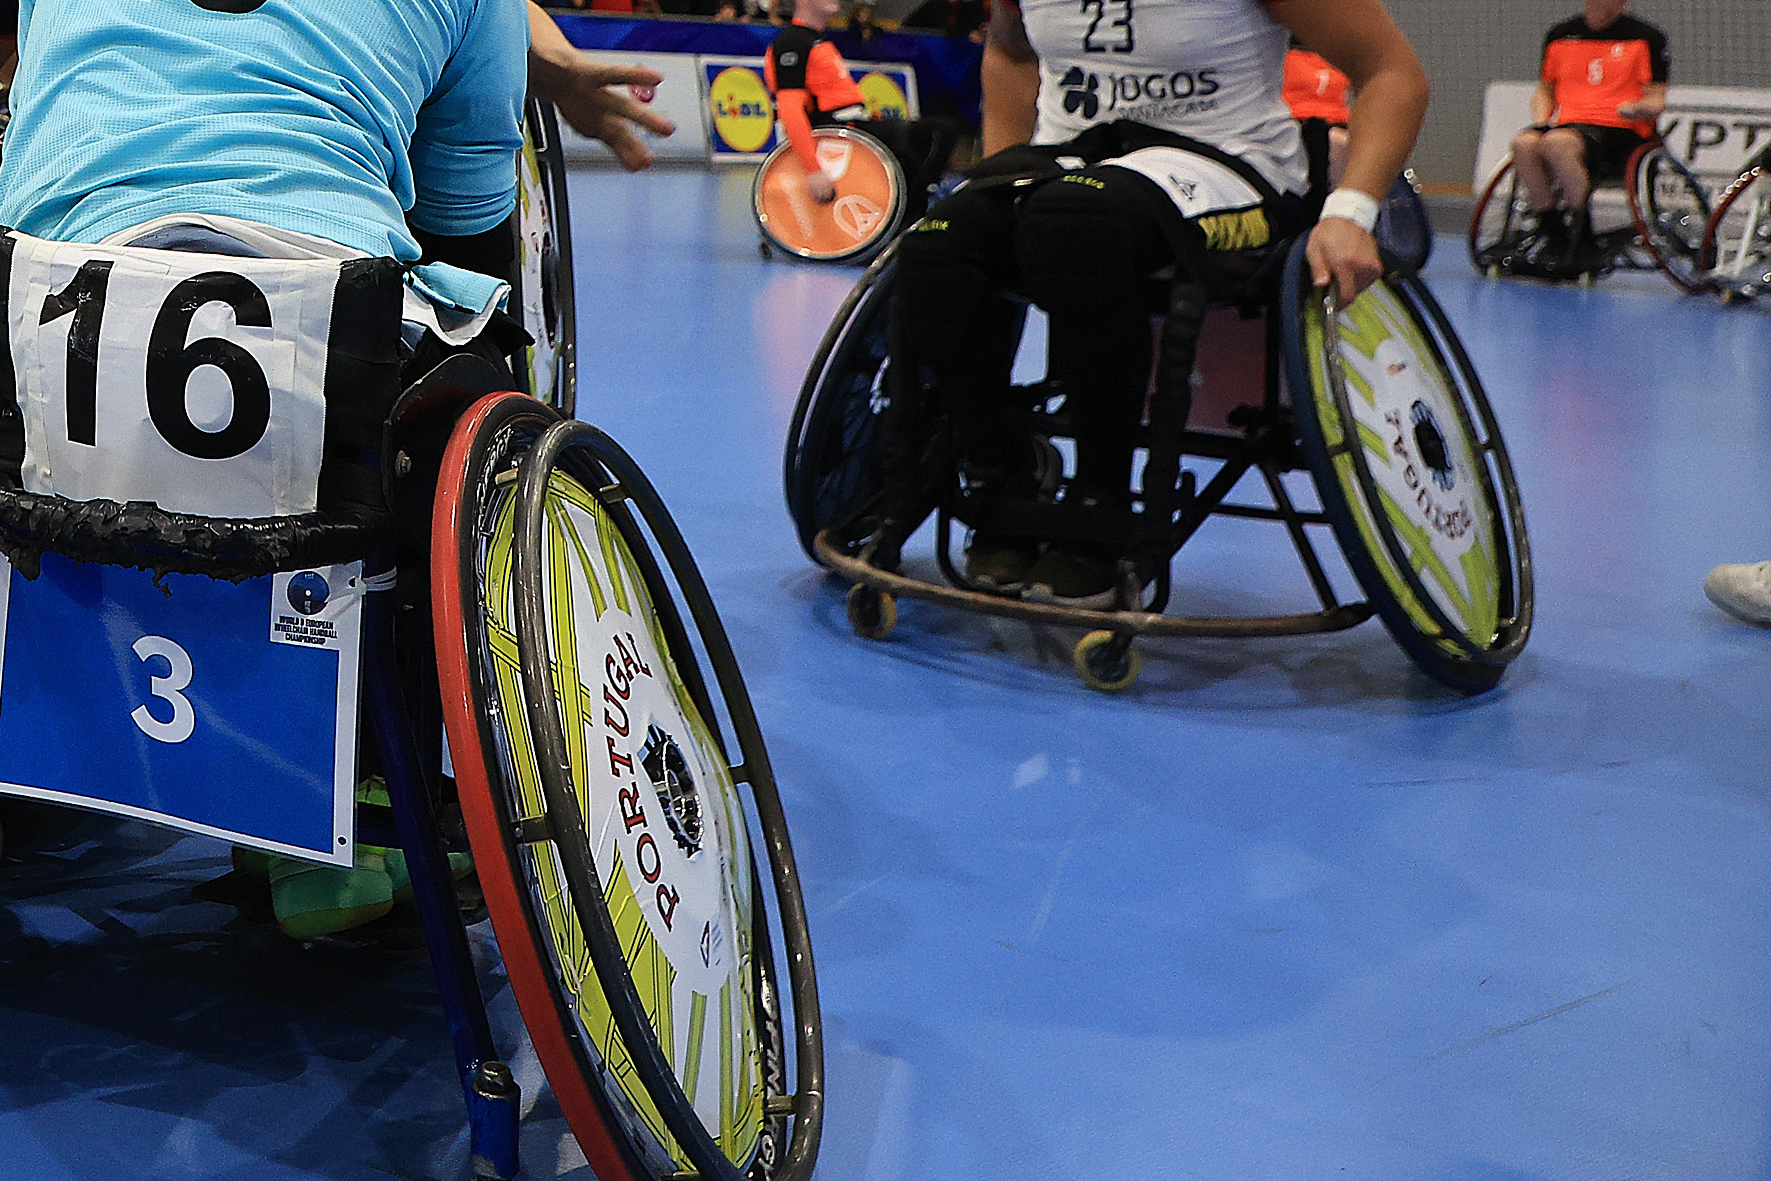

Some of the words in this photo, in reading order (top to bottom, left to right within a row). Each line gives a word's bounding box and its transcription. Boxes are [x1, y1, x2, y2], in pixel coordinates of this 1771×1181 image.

[1107, 67, 1221, 112] JOGOS
[38, 259, 273, 460] 16
[130, 635, 196, 743] 3
[602, 631, 680, 933] PORTUGAL
